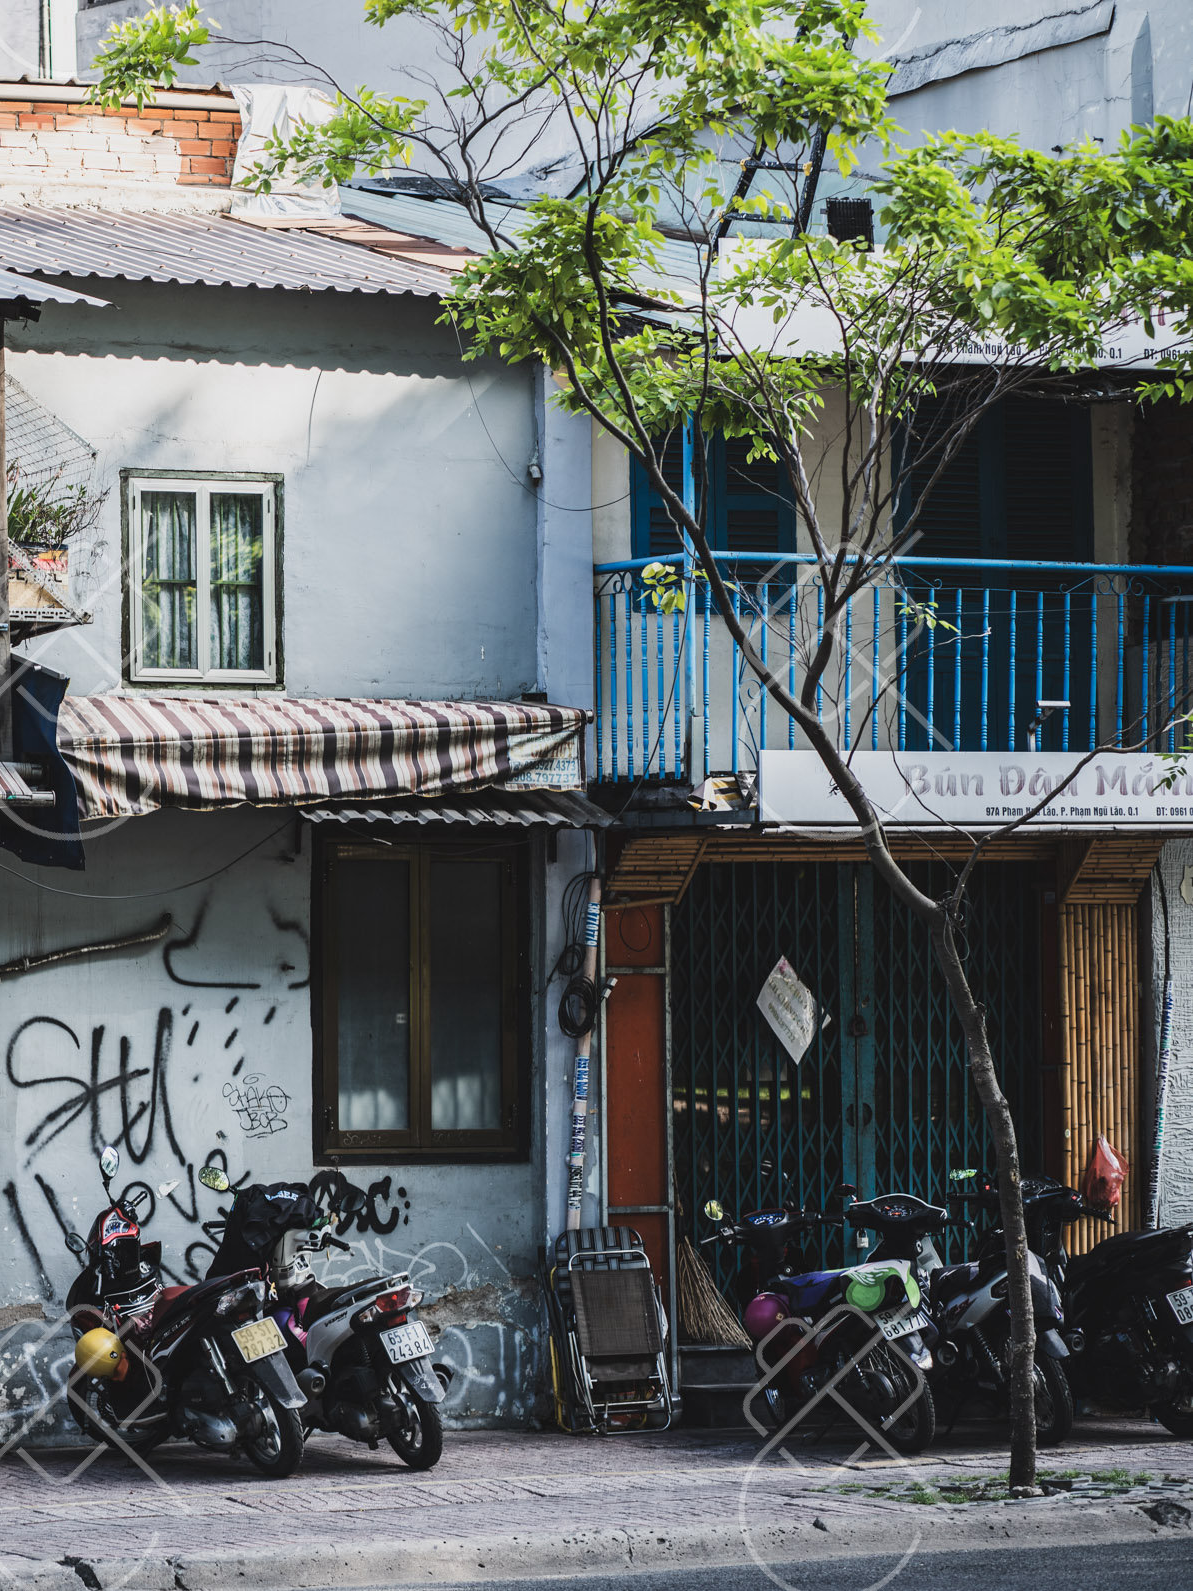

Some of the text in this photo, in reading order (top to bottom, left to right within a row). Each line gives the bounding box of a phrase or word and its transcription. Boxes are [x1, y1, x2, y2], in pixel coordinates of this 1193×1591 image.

[902, 763, 985, 797] Bún
[985, 806, 1000, 817] 97A
[1070, 806, 1092, 819] Phạm
[1093, 805, 1108, 817] Ngũ
[1128, 806, 1139, 817] Q.1
[1156, 806, 1168, 817] ĐT:
[1169, 806, 1187, 817] 0961
[387, 1325, 420, 1346] 65-F1
[389, 1338, 430, 1361] 243.84
